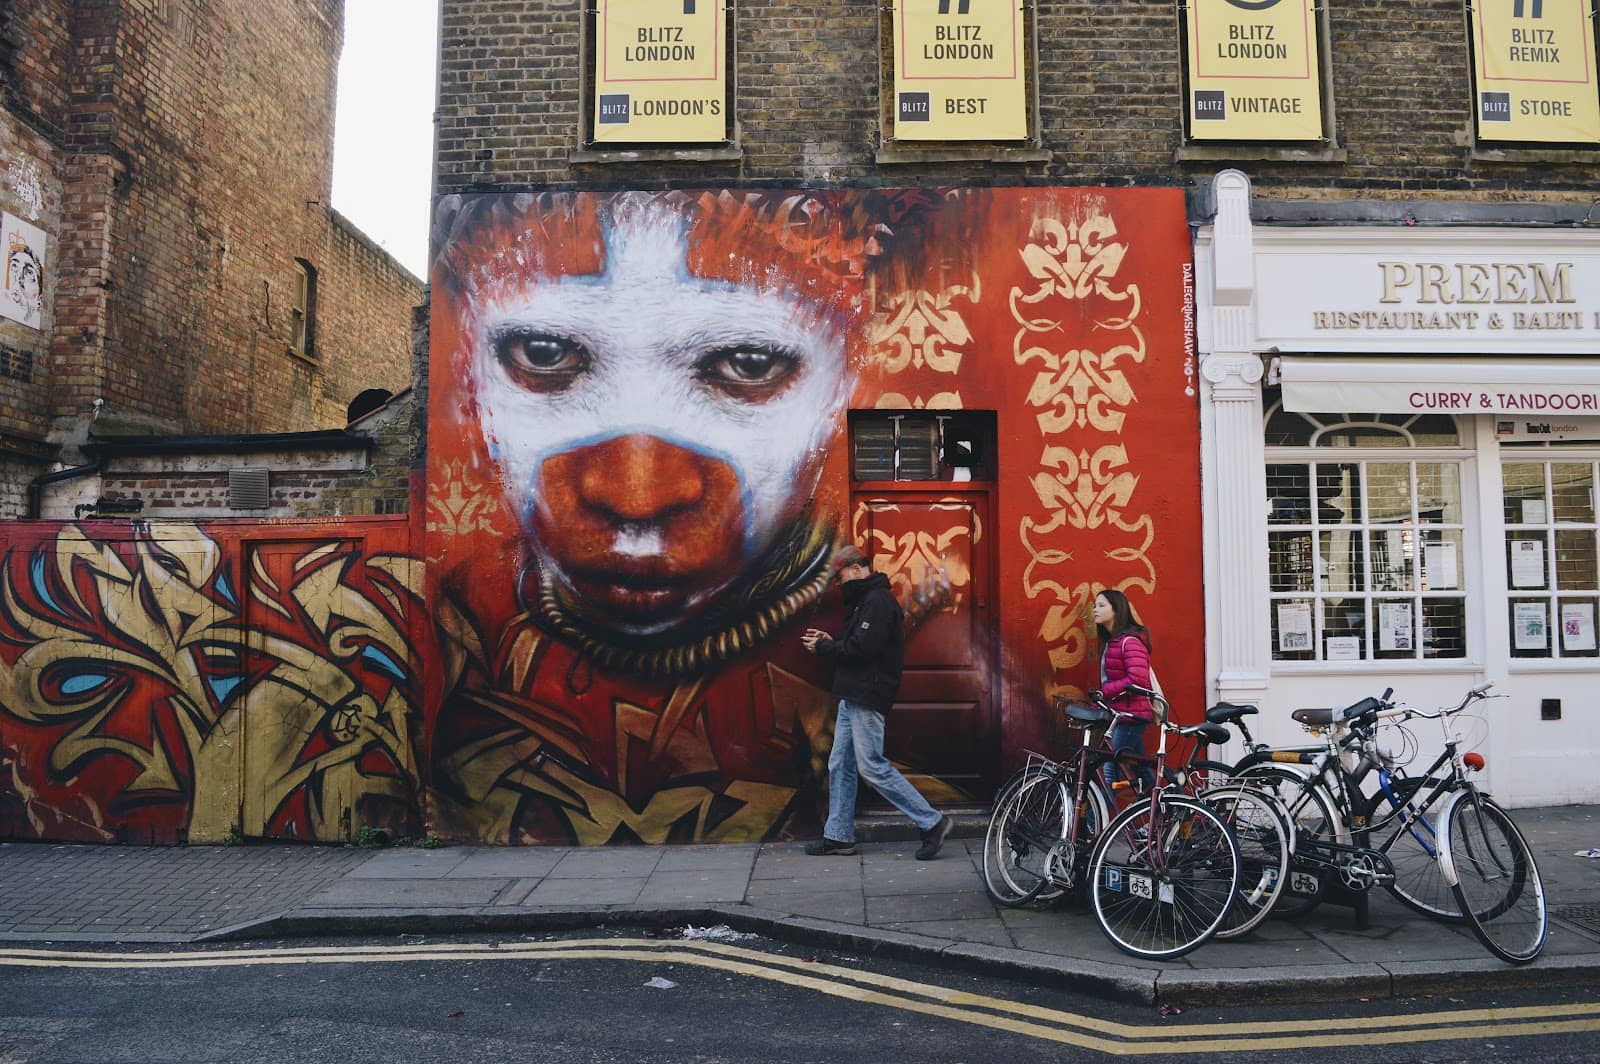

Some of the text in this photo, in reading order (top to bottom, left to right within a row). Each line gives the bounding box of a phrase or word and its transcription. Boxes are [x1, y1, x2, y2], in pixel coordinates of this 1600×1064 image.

[637, 27, 683, 43] BLITZ
[935, 25, 981, 41] BLITZ
[1229, 24, 1275, 41] BLITZ
[1511, 28, 1555, 45] BLITZ
[625, 45, 695, 62] LONDON
[923, 43, 994, 60] LONDON
[1218, 42, 1287, 60] LONDON
[1509, 47, 1560, 64] REMIX
[602, 104, 627, 116] BLITZ
[633, 99, 721, 117] LONDON'S
[902, 101, 927, 114] BLITZ
[945, 98, 988, 115] BEST
[1197, 100, 1223, 112] BLITZ
[1231, 97, 1302, 114] VINTAGE
[1483, 101, 1508, 113] BLITZ
[1520, 99, 1572, 117] STORE
[1378, 261, 1576, 304] PREEM
[1181, 263, 1193, 356] DALEGRIMSHAW
[1313, 311, 1479, 330] RESTAURANT
[1488, 314, 1504, 330] &
[1513, 311, 1584, 330] BALTI
[1409, 392, 1598, 409] CURRY & TANDOORI
[1109, 870, 1118, 888] P
